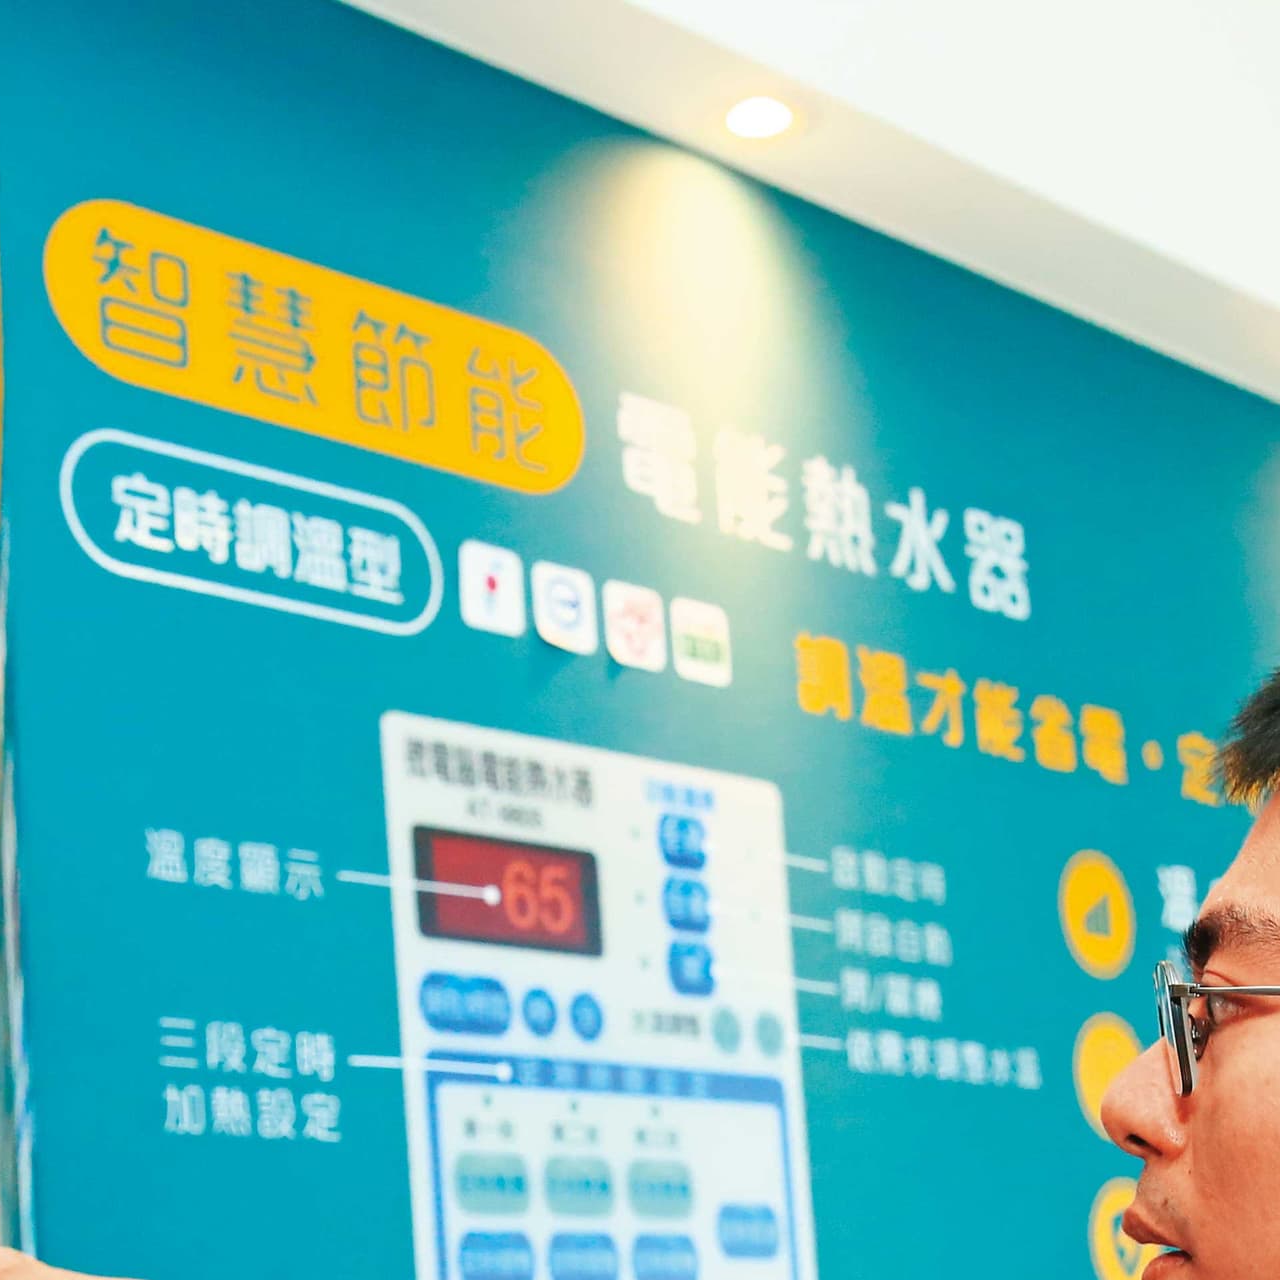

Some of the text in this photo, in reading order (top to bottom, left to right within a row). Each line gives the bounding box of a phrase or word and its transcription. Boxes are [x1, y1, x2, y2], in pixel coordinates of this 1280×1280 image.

[92, 227, 548, 476] 智慧節能
[110, 472, 405, 607] 定時調溫型
[617, 392, 1032, 621] 電能熱水器
[144, 827, 325, 901] 溫度顯示
[500, 861, 573, 934] 65
[158, 1015, 336, 1082] 三段定時
[163, 1083, 343, 1143] 加熱設定
